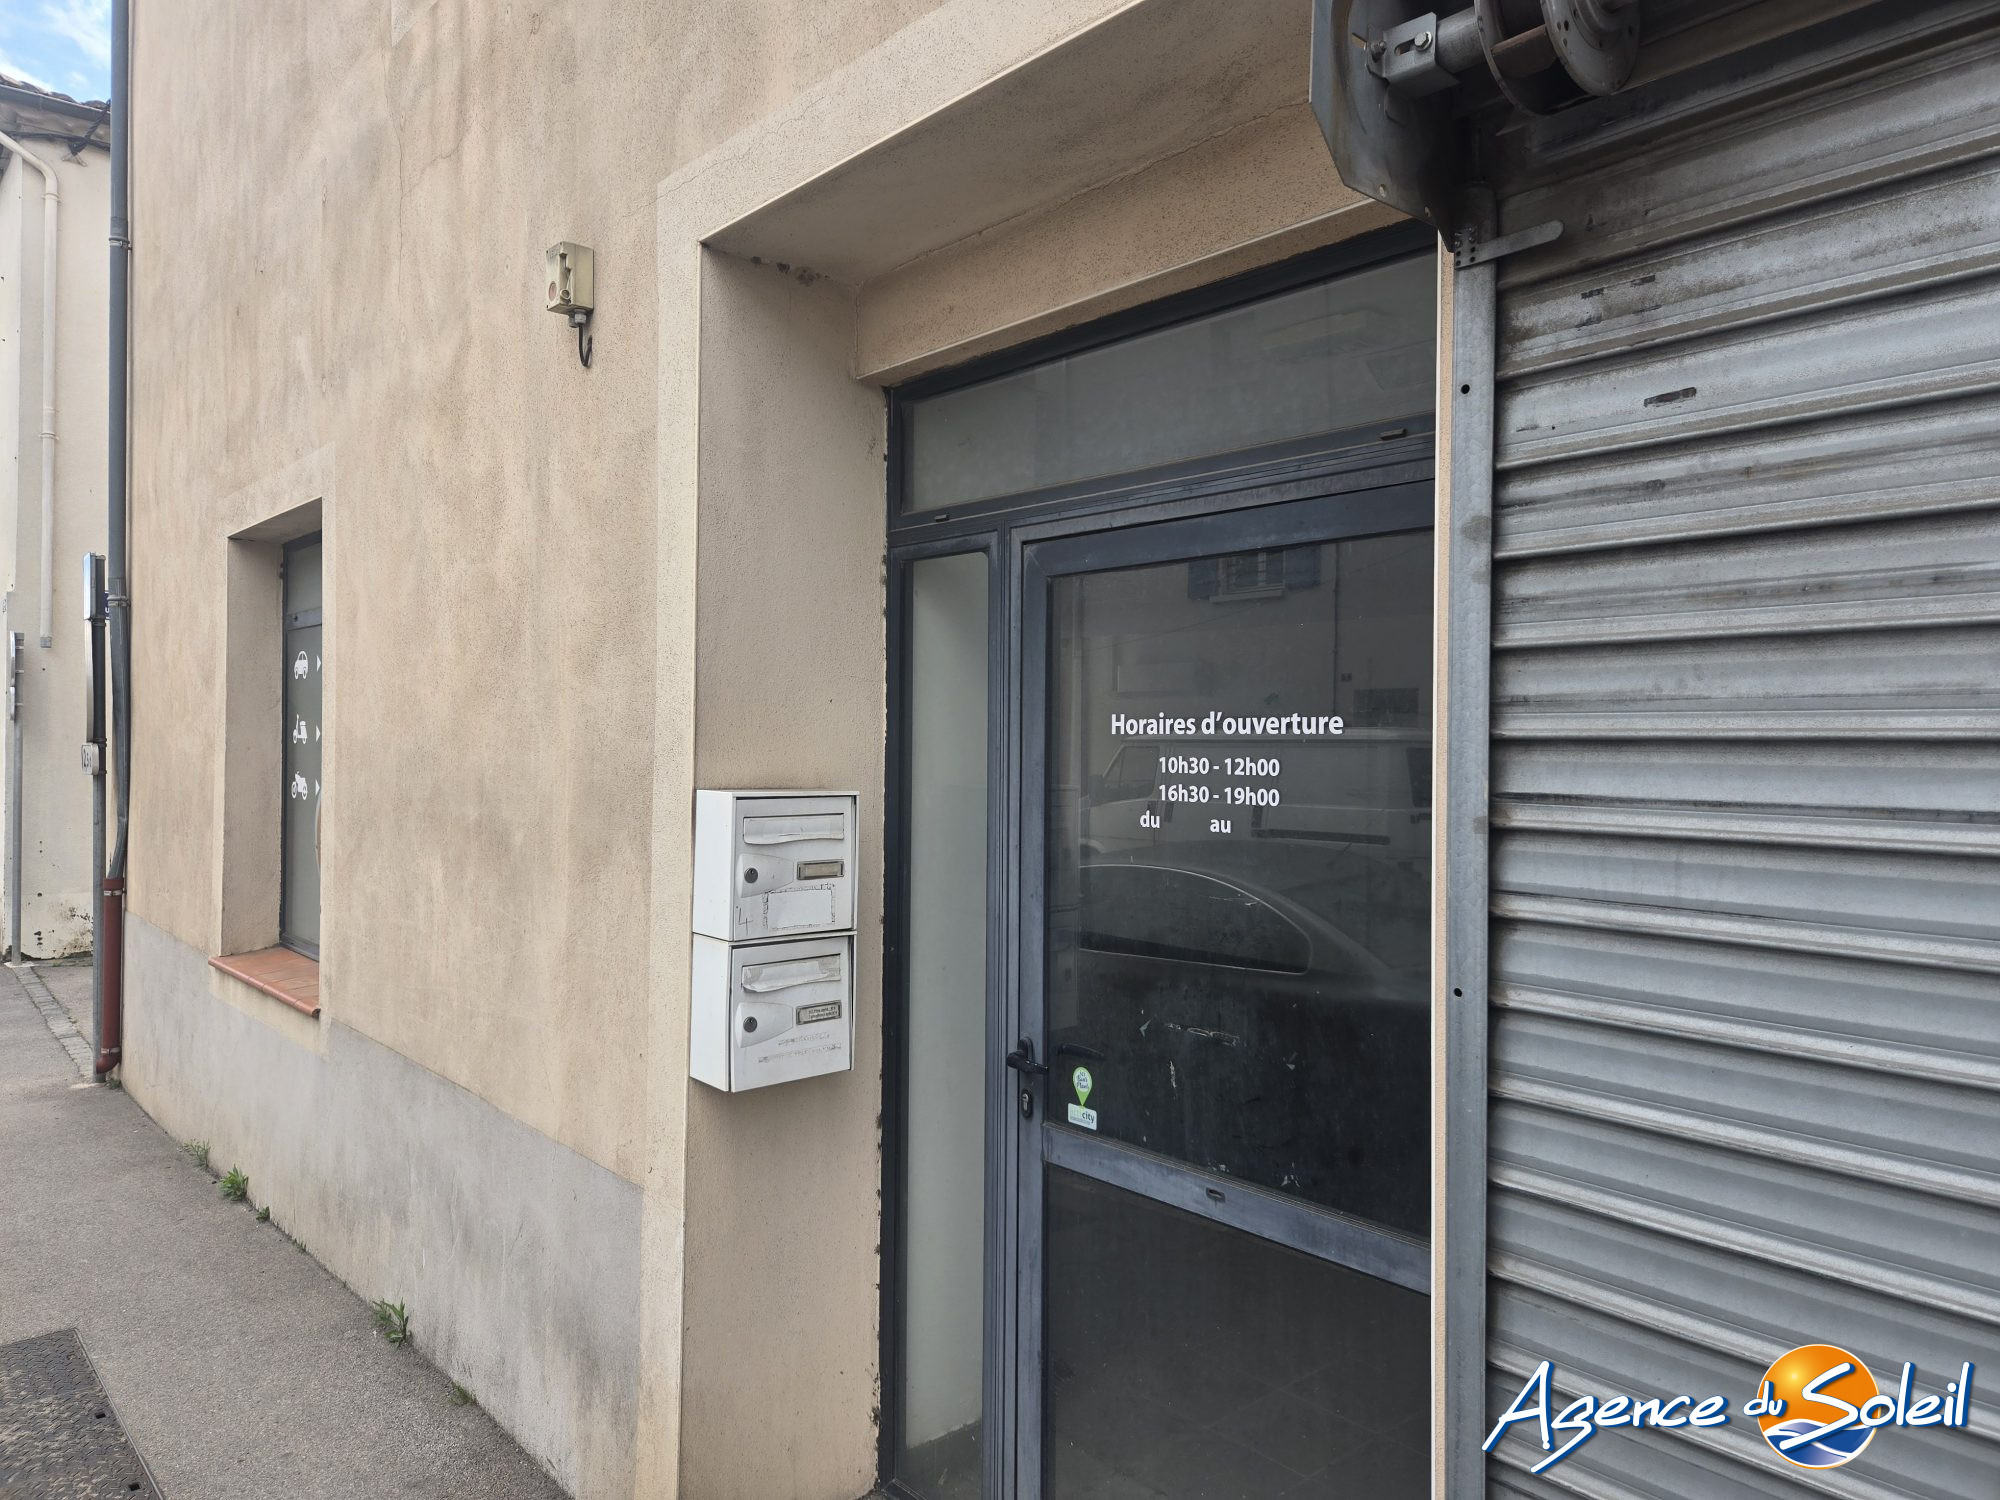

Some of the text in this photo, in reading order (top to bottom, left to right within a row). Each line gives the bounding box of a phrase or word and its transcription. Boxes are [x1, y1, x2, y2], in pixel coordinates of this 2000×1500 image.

[1111, 711, 1344, 735] Horaires d’ouverture
[1158, 756, 1210, 775] 10h30
[1224, 757, 1280, 777] 12h00
[1158, 784, 1210, 803] 16h30
[1224, 787, 1280, 807] 19h00
[1139, 810, 1232, 834] du au
[1081, 1110, 1095, 1124] city
